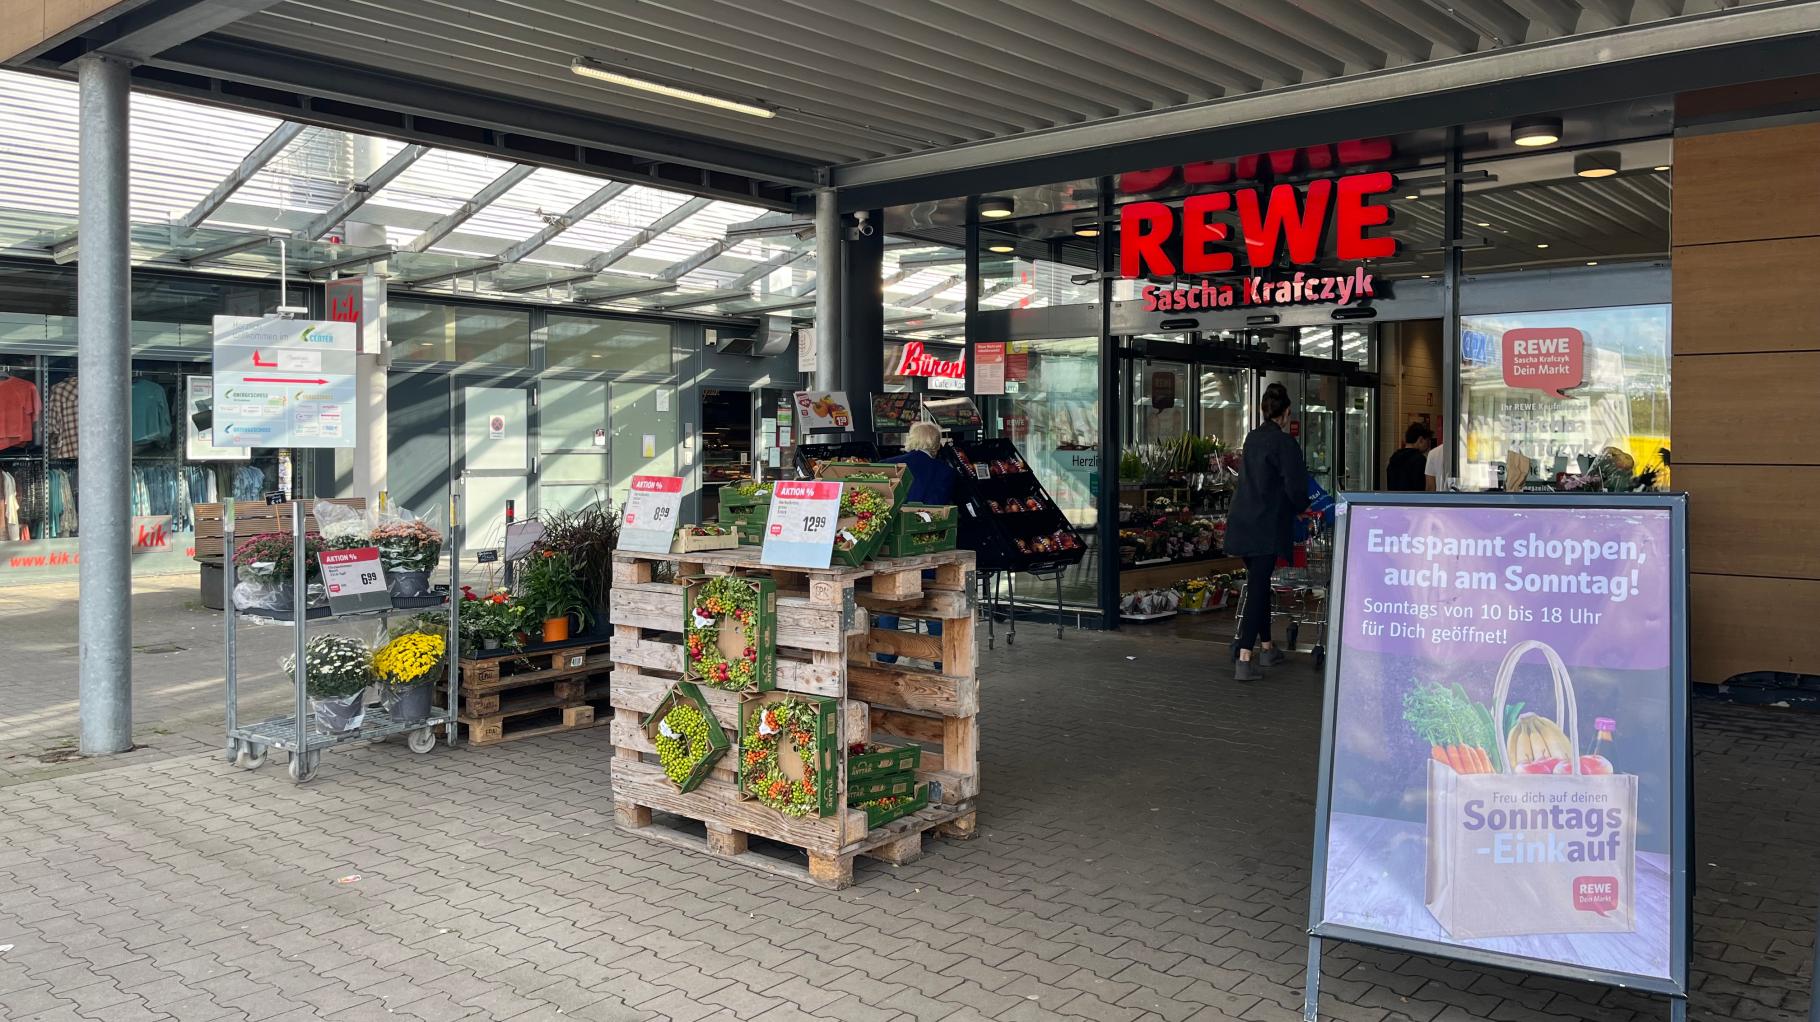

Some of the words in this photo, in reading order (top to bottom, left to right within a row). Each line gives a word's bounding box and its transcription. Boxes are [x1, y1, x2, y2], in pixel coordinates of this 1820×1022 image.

[1120, 172, 1396, 279] REWE
[1142, 280, 1233, 312] Sascha
[1243, 267, 1374, 305] Krafczyk
[309, 334, 334, 343] CENTER
[1513, 338, 1570, 355] REWE
[1514, 356, 1538, 364] Sascha
[1539, 355, 1569, 364] Krafczyk
[1513, 365, 1536, 376] Dein
[1538, 364, 1570, 375] Markt
[1501, 403, 1513, 411] Ihr
[1514, 403, 1537, 411] REWE
[1072, 454, 1099, 467] Herzli
[636, 481, 655, 489] AKTION
[781, 487, 805, 497] AKTION
[806, 488, 815, 497] %
[653, 506, 670, 521] 8.99
[803, 516, 827, 532] 12.99
[137, 524, 168, 547] kik
[1368, 528, 1506, 561] Entspannt
[1513, 532, 1647, 566] shoppen,
[326, 554, 349, 563] AKTION
[360, 572, 378, 585] 6.99
[1384, 563, 1448, 588] auch
[1455, 569, 1497, 590] am
[1504, 565, 1639, 602] Sonntag!
[1363, 598, 1438, 619] Sonntags
[1443, 606, 1473, 618] von
[1481, 604, 1501, 620] 10
[1508, 604, 1533, 622] bis
[1541, 607, 1562, 623] 18
[1570, 607, 1602, 624] Uhr
[1362, 620, 1384, 636] für
[1390, 622, 1425, 639] Dich
[1432, 626, 1507, 644] geöffnet!
[1493, 791, 1517, 803] Freu
[1521, 791, 1545, 803] dich
[1549, 791, 1568, 803] auf
[1571, 791, 1608, 803] deinen
[1463, 800, 1622, 837] Sonntags
[1477, 831, 1621, 864] -Einkauf
[1580, 884, 1612, 894] REWE
[1580, 895, 1592, 903] Dein
[1593, 895, 1612, 903] Markt
